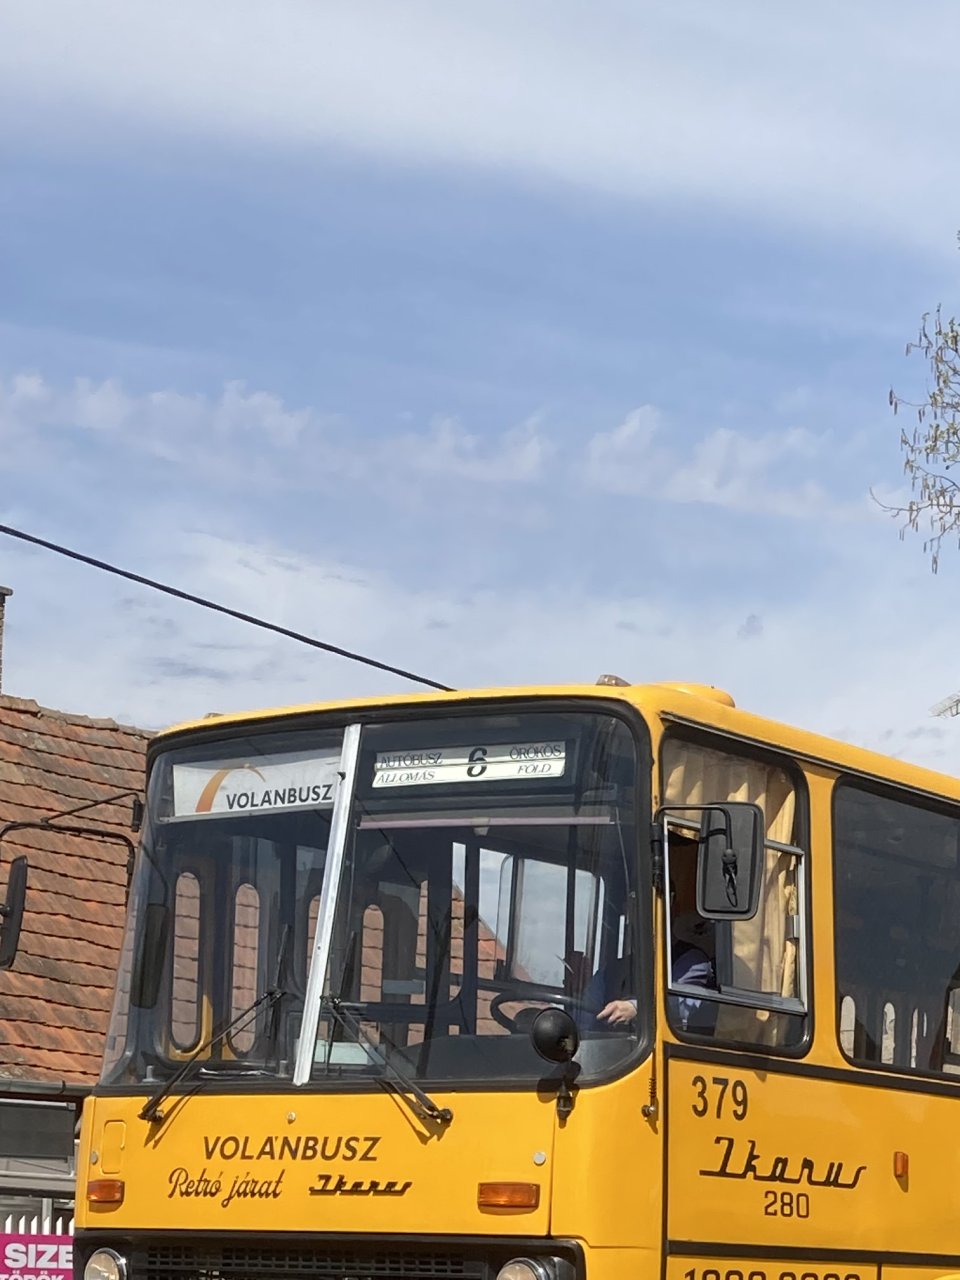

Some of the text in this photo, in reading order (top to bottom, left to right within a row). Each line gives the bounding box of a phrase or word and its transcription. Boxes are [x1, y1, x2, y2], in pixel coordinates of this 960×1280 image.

[380, 743, 562, 778] AUTÓBUSZ 6 ÖRÖKÖS
[226, 783, 333, 810] VOLÁNBUSZ
[691, 1075, 749, 1121] 379
[203, 1136, 382, 1162] VOLÁNBUSZ
[699, 1136, 867, 1189] Ikarus
[168, 1167, 286, 1209] Retró járat
[764, 1190, 810, 1218] 280
[4, 1242, 74, 1270] SIZE
